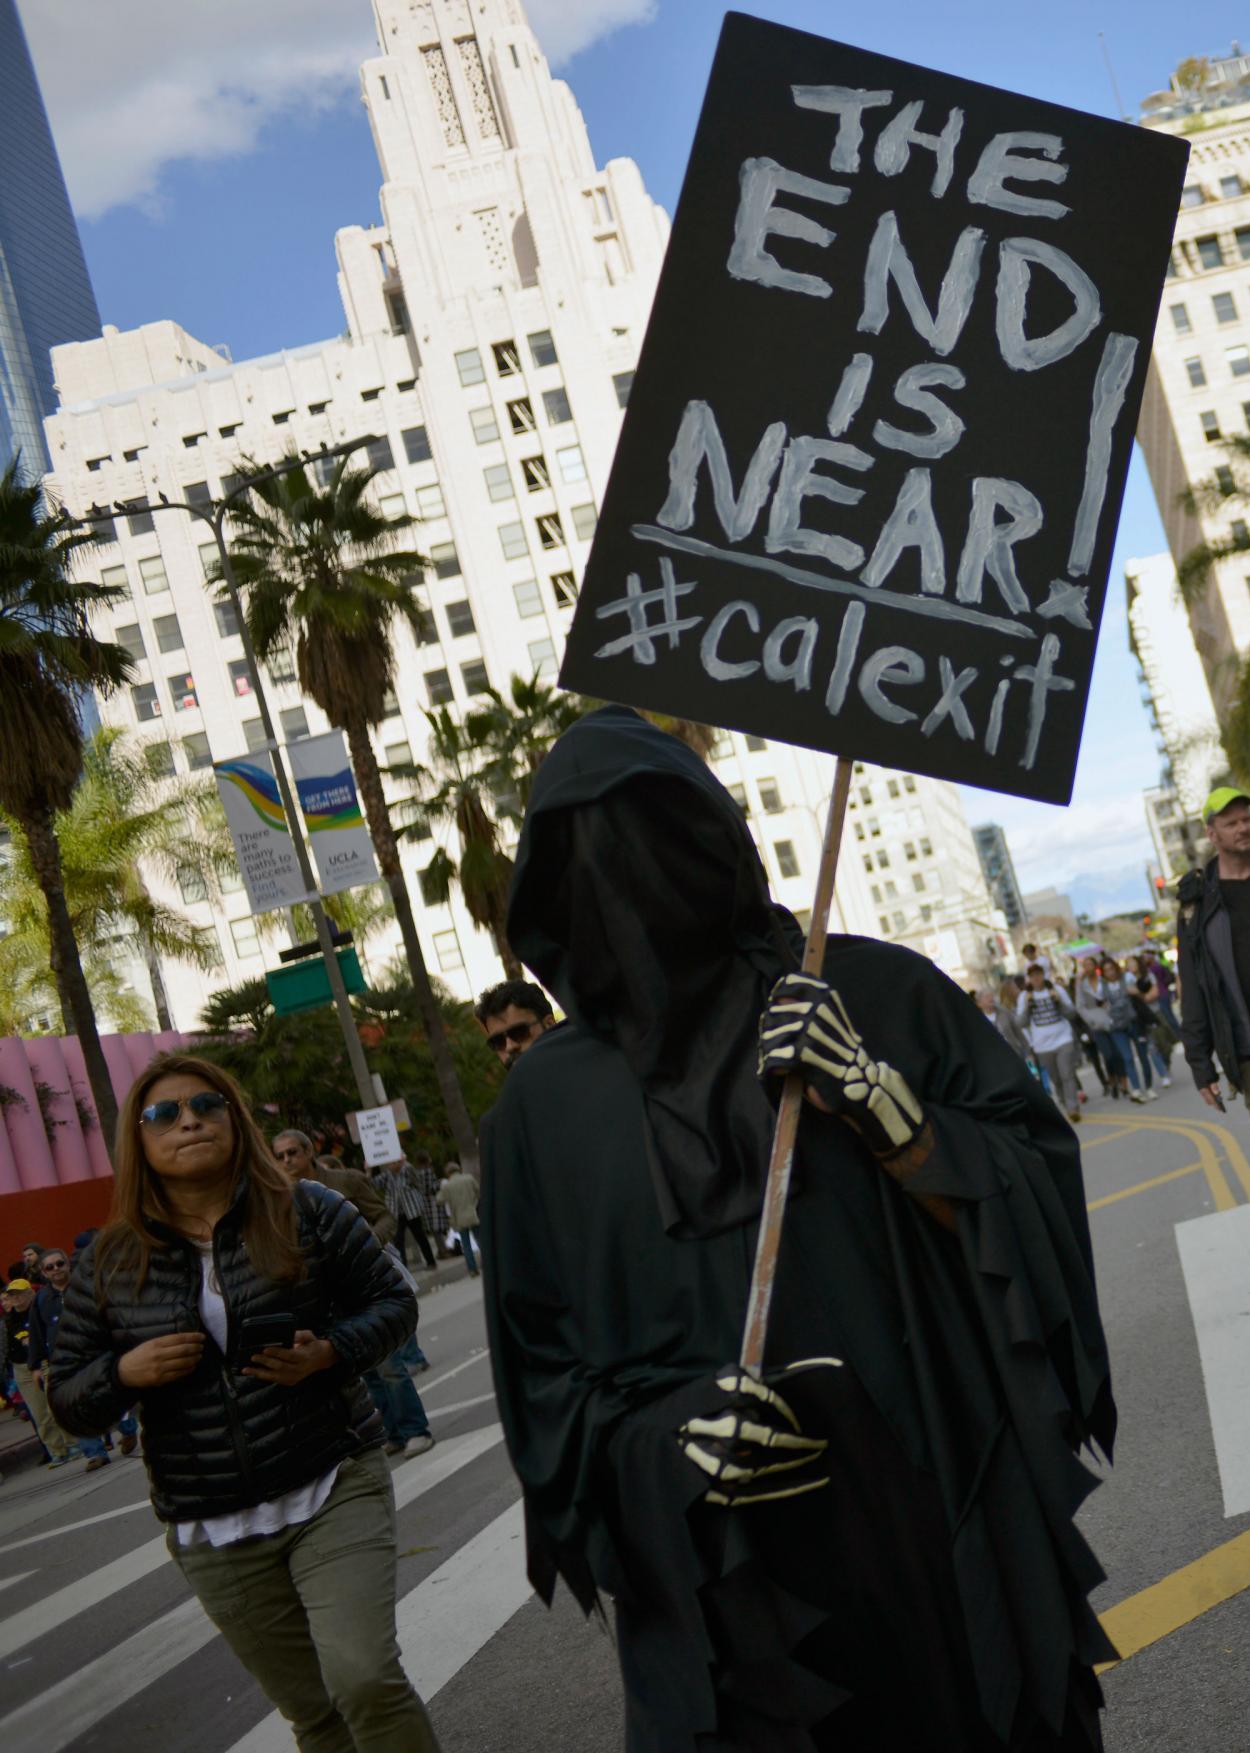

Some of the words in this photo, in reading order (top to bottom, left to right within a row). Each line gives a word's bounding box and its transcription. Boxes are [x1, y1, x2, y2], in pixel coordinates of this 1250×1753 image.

[790, 84, 1073, 219] THE
[726, 155, 1103, 373] END
[827, 352, 966, 460] IS
[594, 556, 1076, 771] #calexit
[323, 785, 350, 797] THERE
[307, 801, 331, 813] FROM
[331, 794, 353, 807] HERE
[238, 829, 270, 843] There
[241, 842, 258, 853] are
[244, 848, 274, 863] many
[246, 859, 277, 875] paths
[279, 854, 292, 863] to
[328, 850, 359, 866] UCLA
